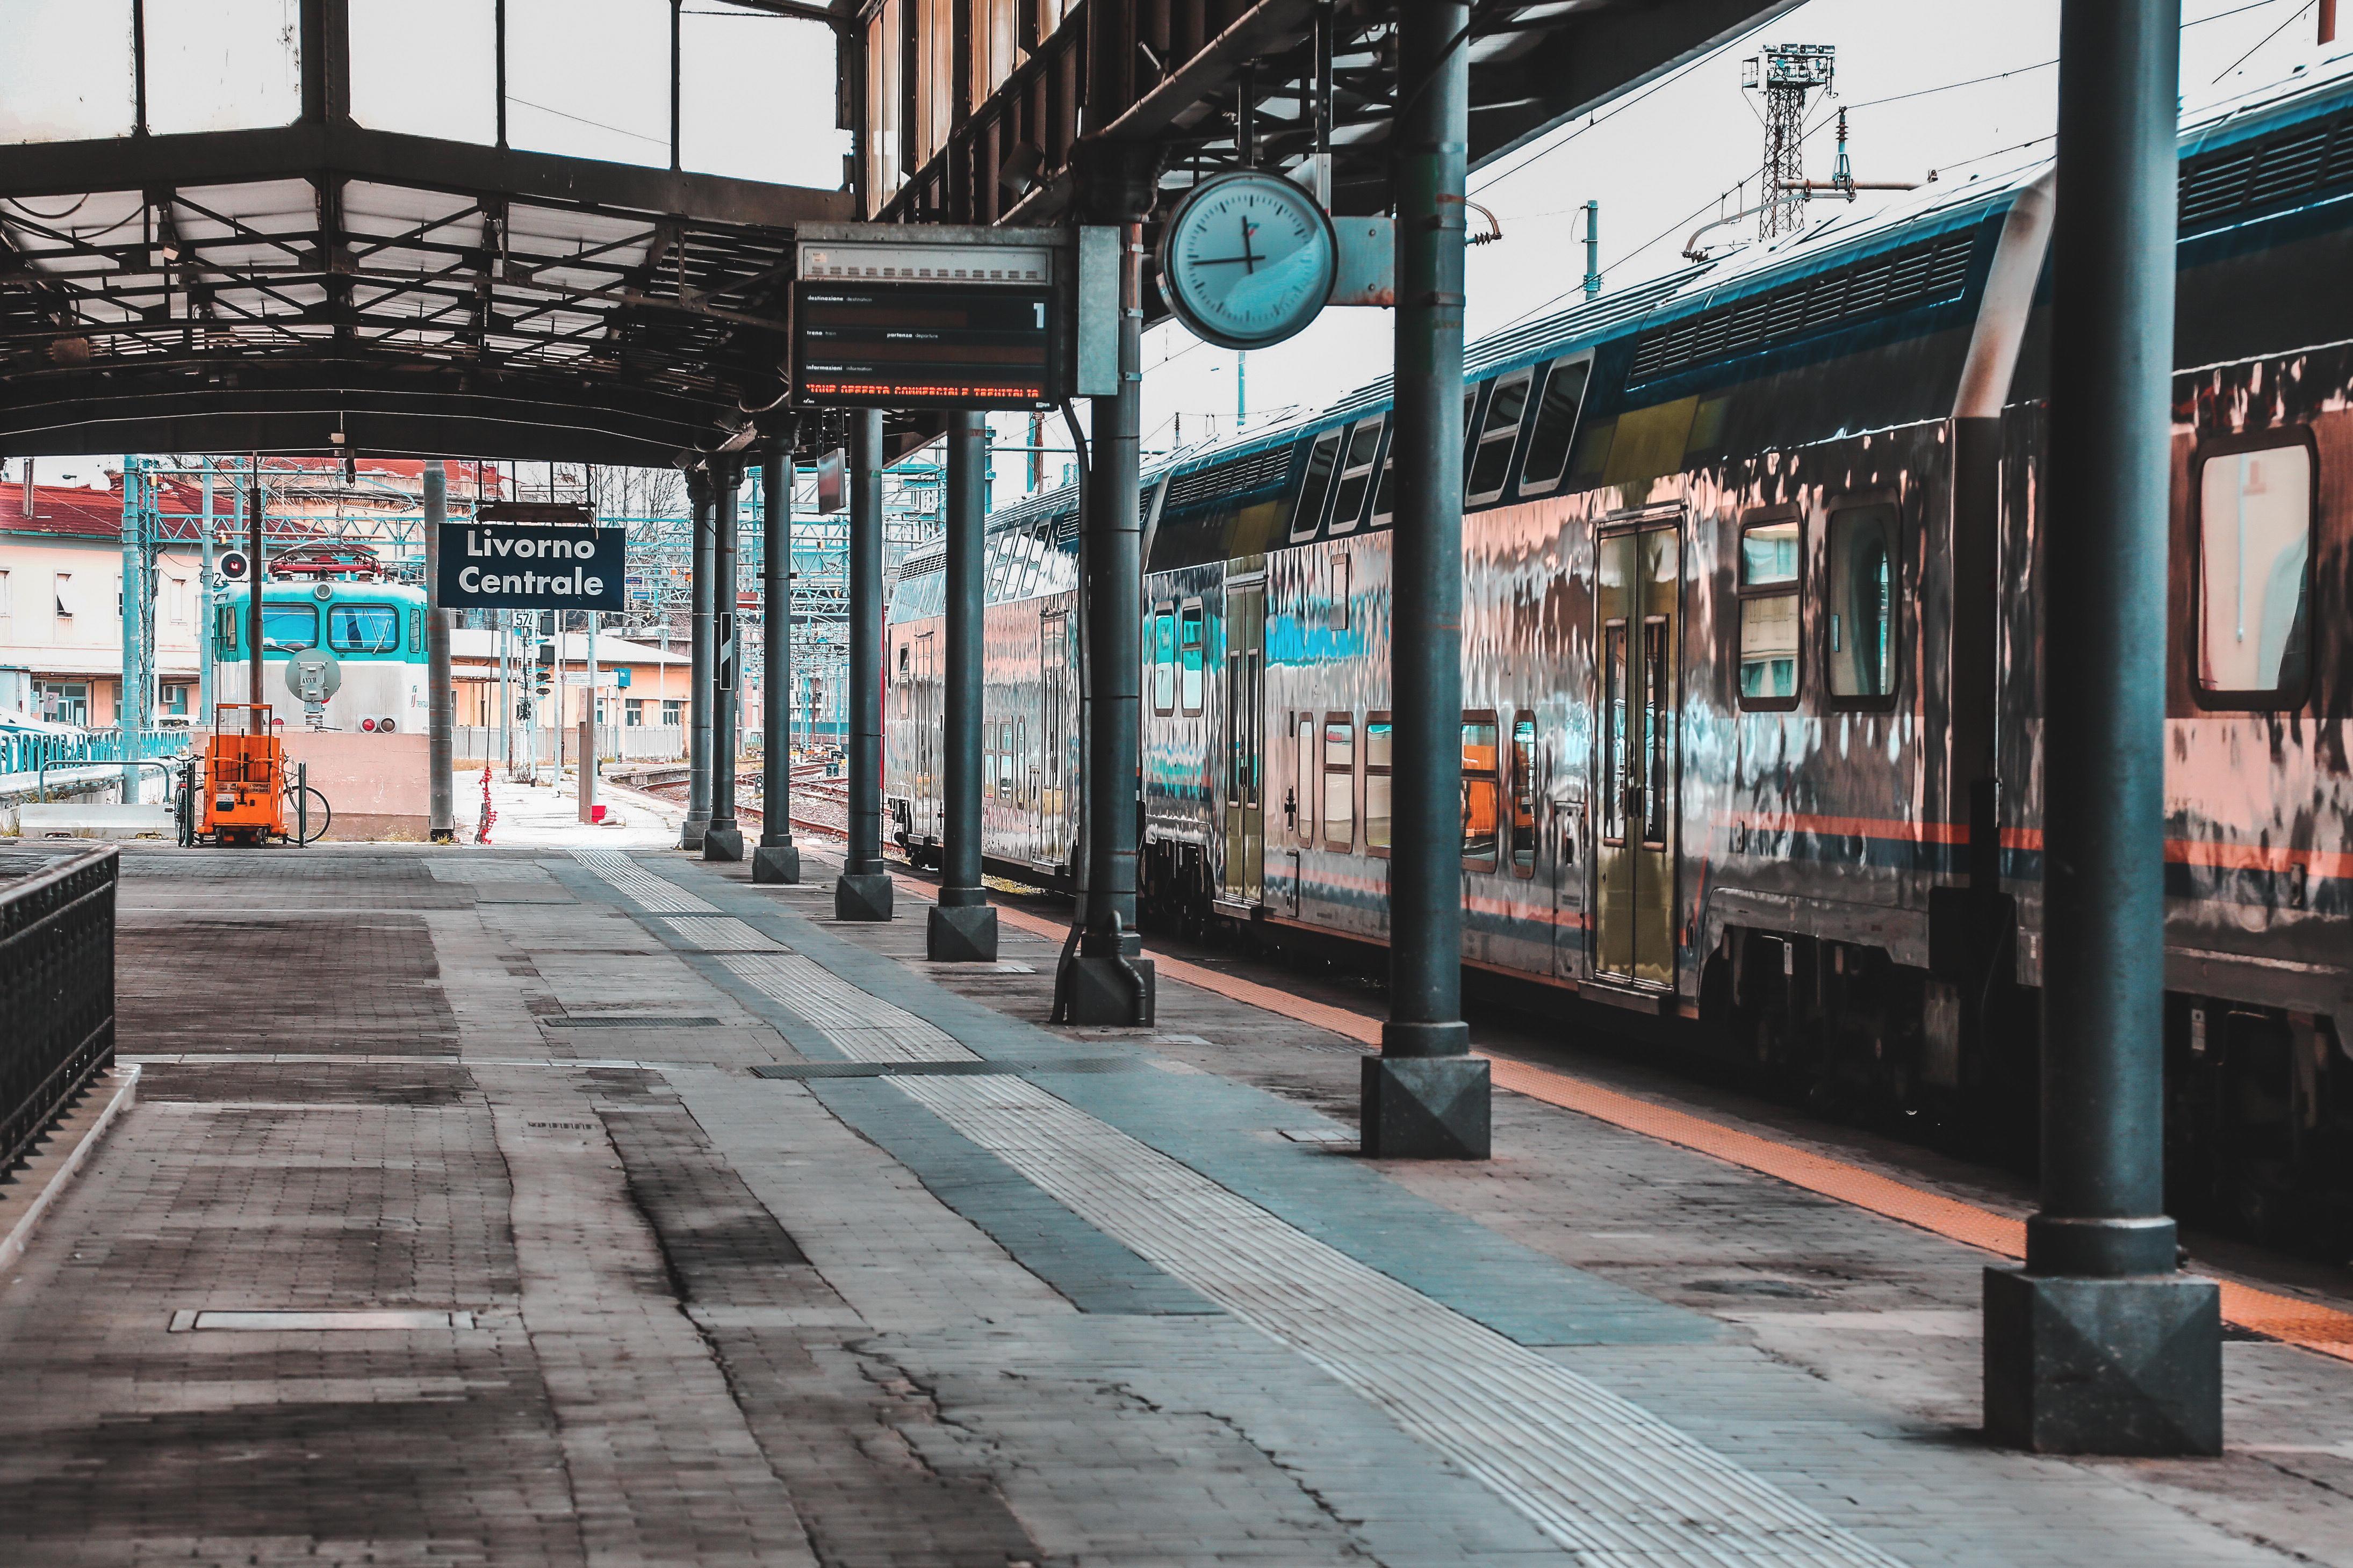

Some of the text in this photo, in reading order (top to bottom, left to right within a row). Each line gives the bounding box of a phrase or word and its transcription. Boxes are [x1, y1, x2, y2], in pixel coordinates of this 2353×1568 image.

[1033, 302, 1045, 329] 1
[467, 529, 595, 559] Livorno
[458, 566, 603, 595] Centrale
